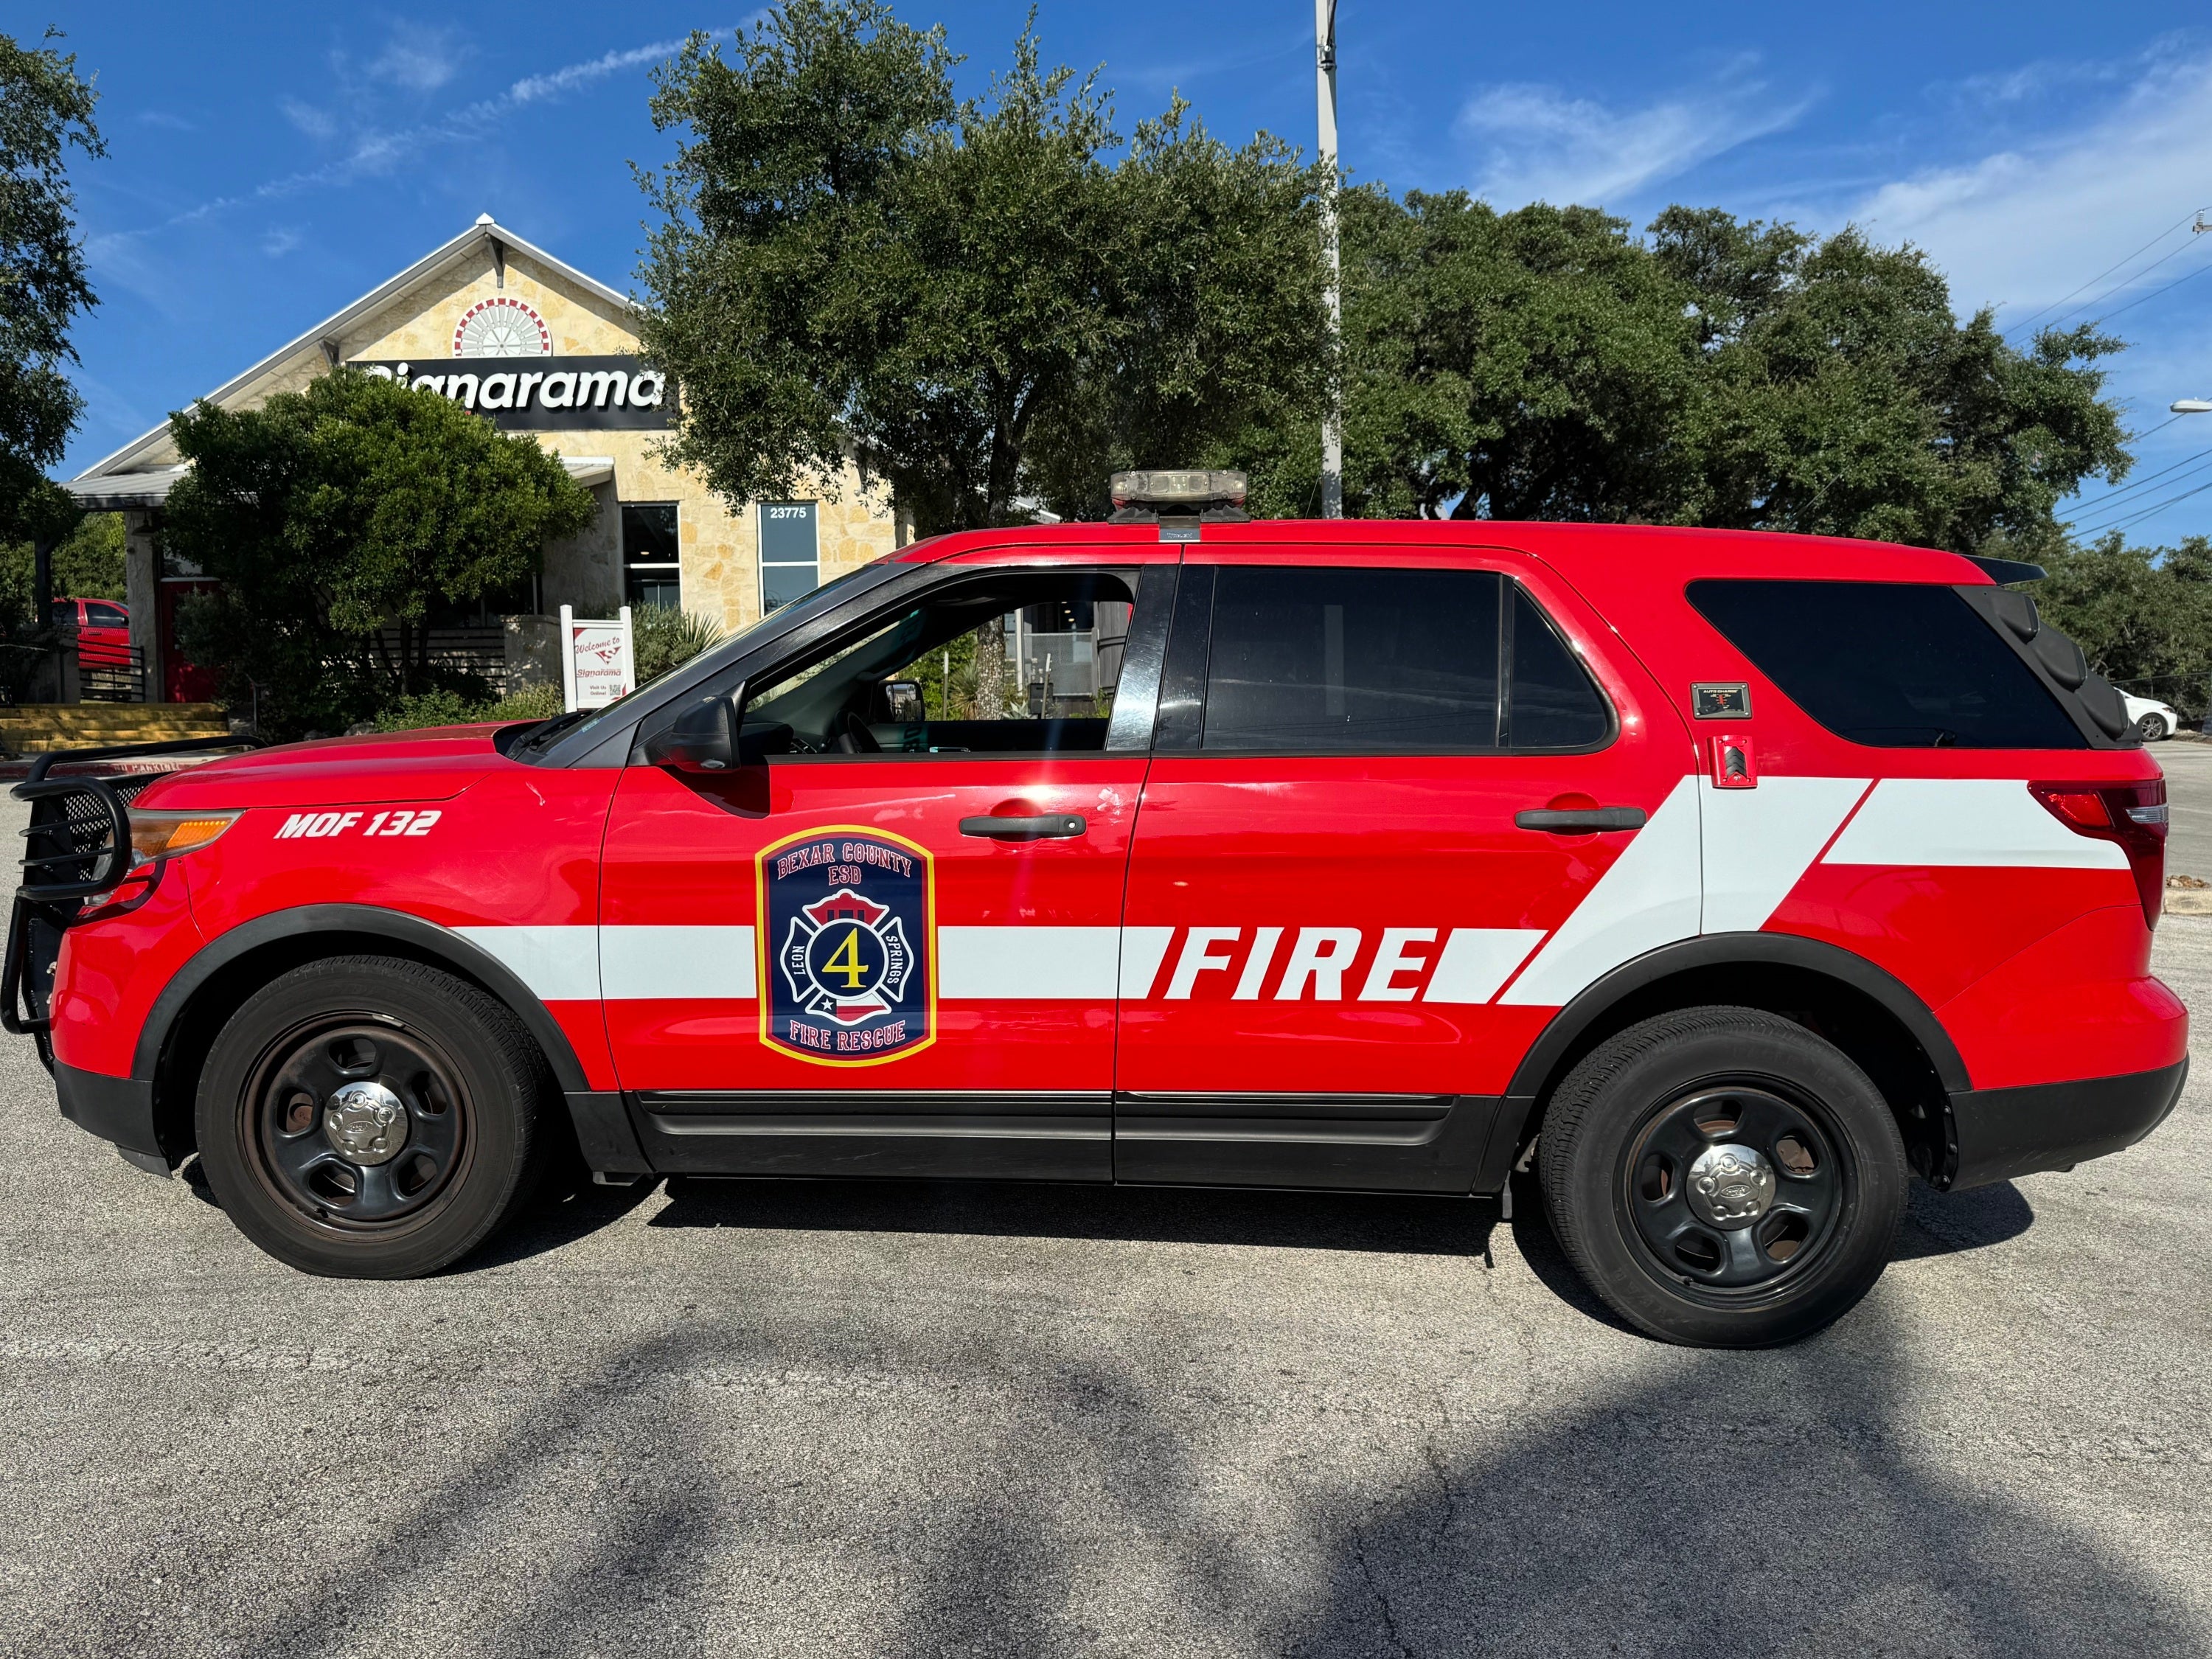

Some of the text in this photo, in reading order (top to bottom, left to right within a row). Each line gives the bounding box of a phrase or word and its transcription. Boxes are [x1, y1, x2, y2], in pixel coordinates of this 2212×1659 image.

[770, 507, 807, 519] 23775
[575, 636, 620, 654] Welcome to
[577, 669, 622, 678] Signarama
[273, 810, 442, 839] MOF 132
[777, 842, 912, 880] BEXAR COUNTY
[828, 865, 862, 886] ESD
[791, 945, 806, 975] LEON
[821, 927, 869, 988] 4
[886, 935, 904, 984] SPRINGS
[1164, 926, 1439, 1001] FIRE
[789, 1019, 905, 1051] FIRE RESCUE
